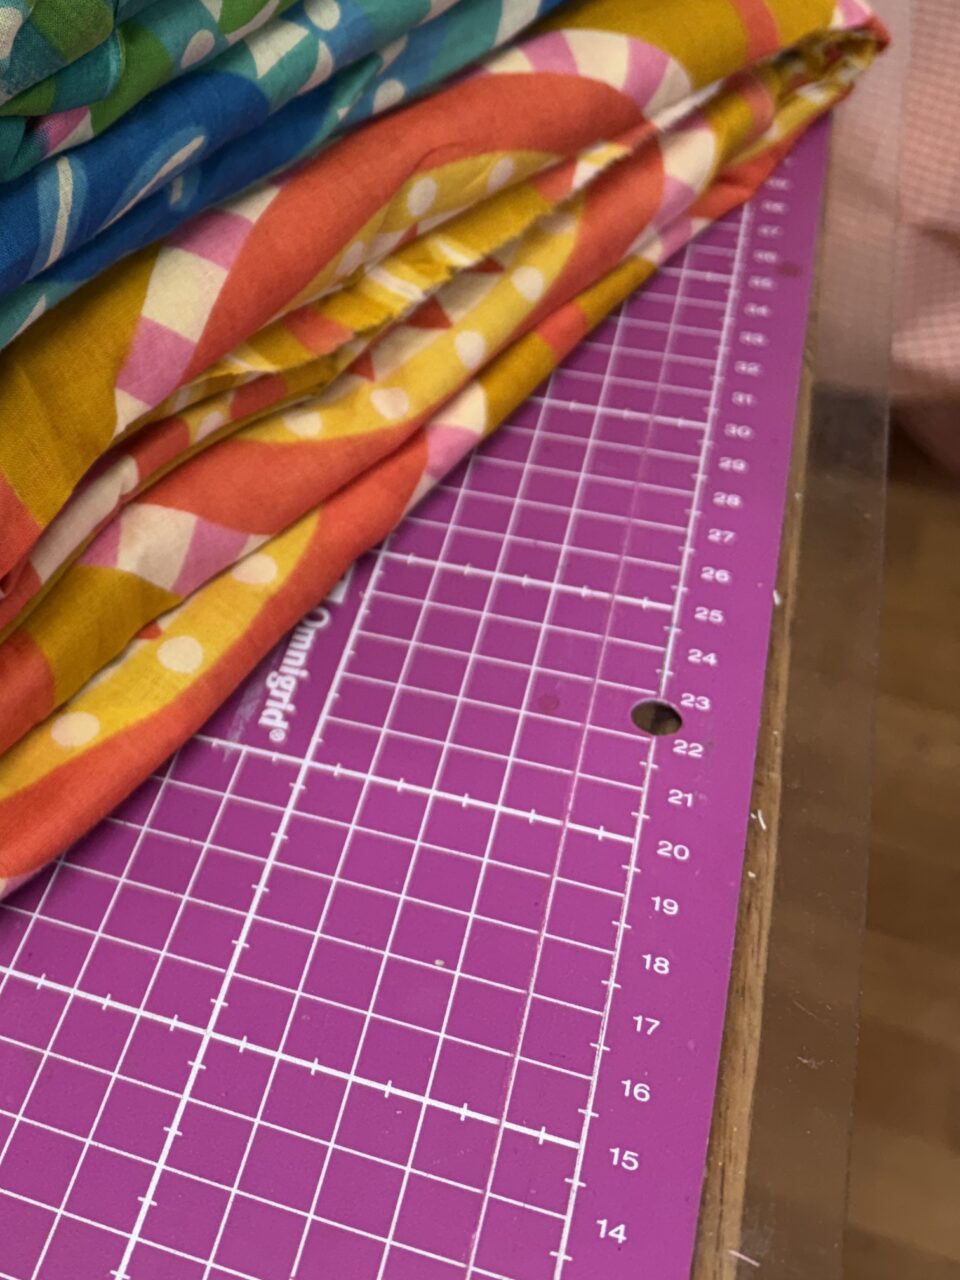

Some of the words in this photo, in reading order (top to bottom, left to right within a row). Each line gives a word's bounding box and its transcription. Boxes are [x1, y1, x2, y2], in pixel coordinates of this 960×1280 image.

[726, 424, 752, 438] 30
[718, 457, 747, 472] 29
[713, 491, 742, 507] 28
[707, 528, 735, 543] 27
[700, 566, 731, 583] 26
[694, 606, 724, 624] 25
[687, 648, 718, 666] 24
[680, 692, 712, 712] 23
[672, 739, 704, 758] 22
[667, 788, 693, 808] 21
[656, 840, 690, 861] 20
[651, 895, 679, 916] 19
[642, 953, 670, 975] 18
[632, 1015, 661, 1035] 17
[621, 1079, 651, 1103] 16
[609, 1147, 639, 1171] 15
[596, 1218, 627, 1244] 14
